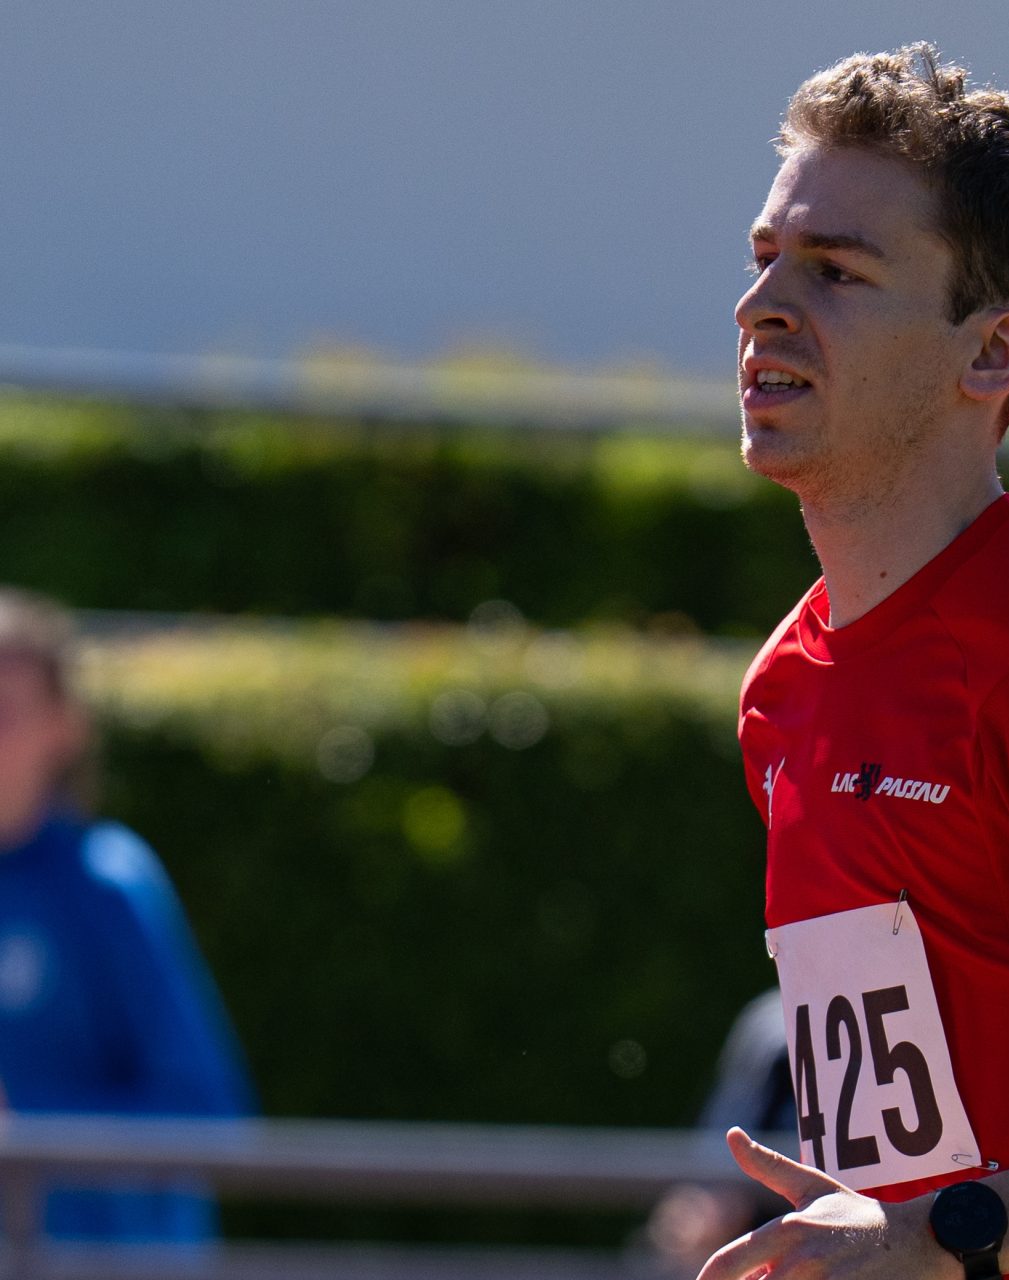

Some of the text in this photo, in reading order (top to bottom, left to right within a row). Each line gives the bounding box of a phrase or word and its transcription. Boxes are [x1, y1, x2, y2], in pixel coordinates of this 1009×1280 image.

[831, 773, 950, 804] LAC PASSAU
[796, 985, 943, 1173] 425
